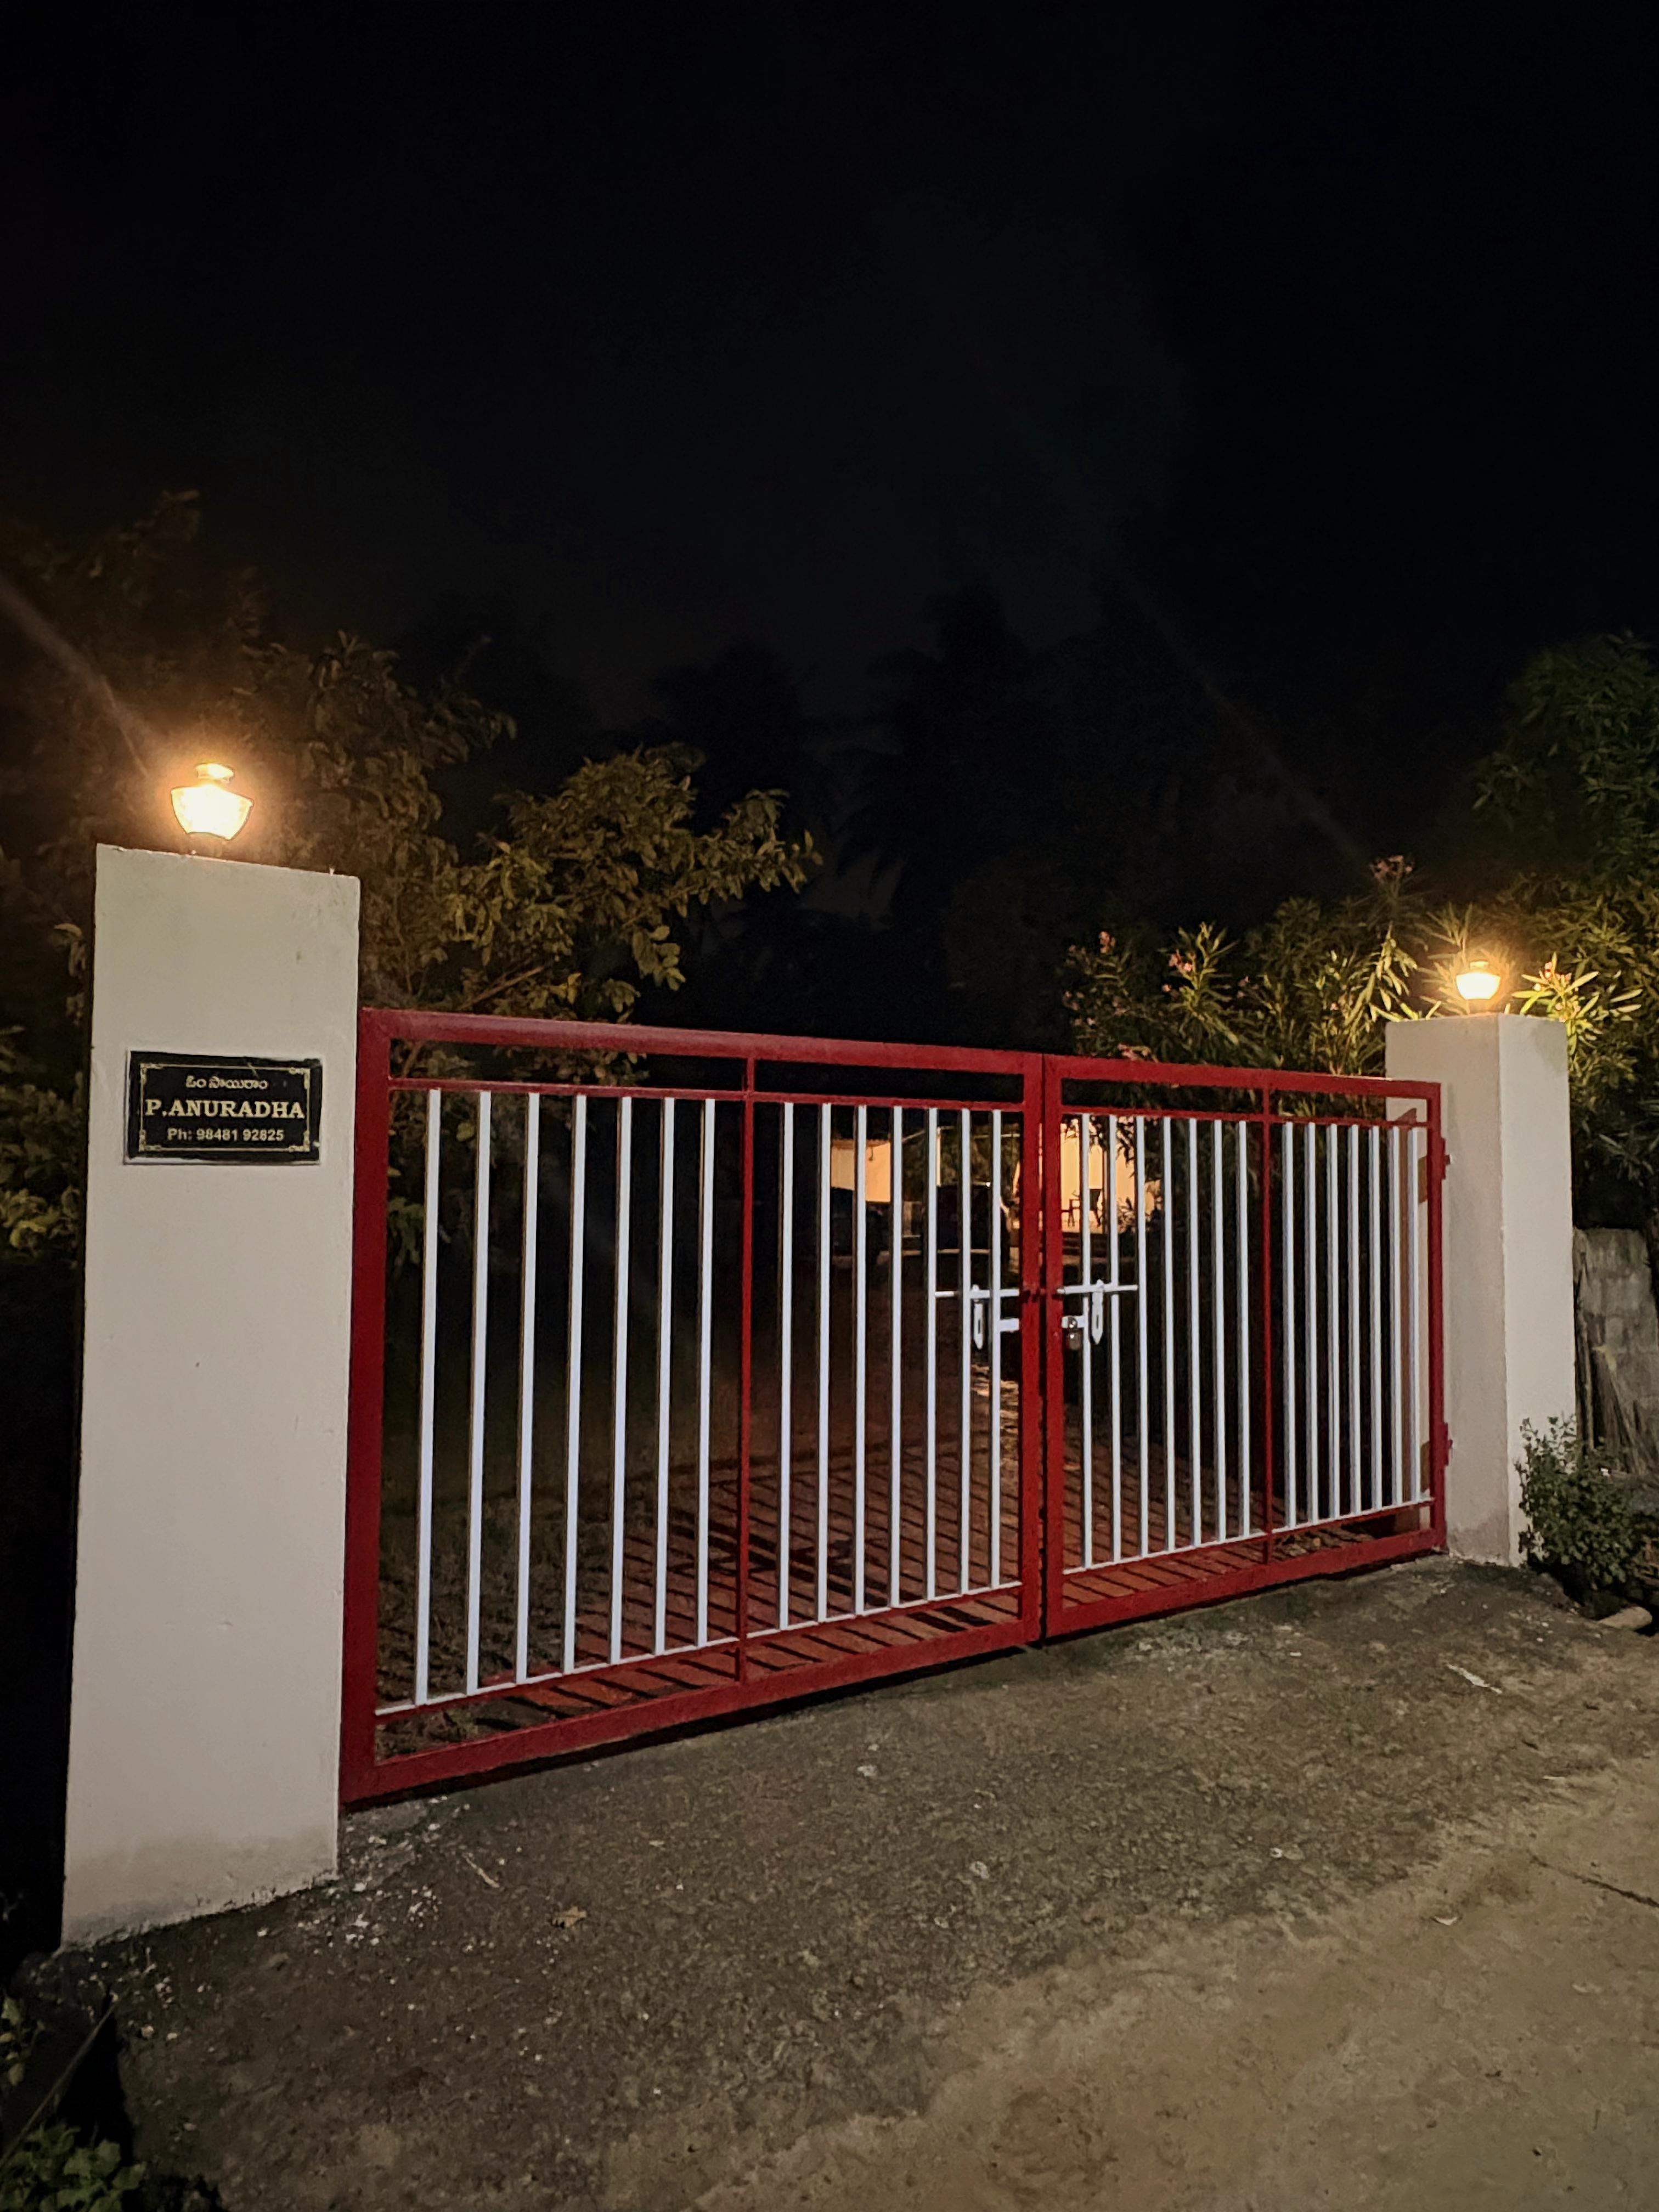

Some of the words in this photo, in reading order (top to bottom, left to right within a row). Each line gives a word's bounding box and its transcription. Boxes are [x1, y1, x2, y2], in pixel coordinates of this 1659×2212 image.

[145, 1099, 305, 1119] P.ANURADHA
[167, 1128, 192, 1141] Ph:
[196, 1128, 238, 1142] 98481
[242, 1128, 285, 1142] 92825
